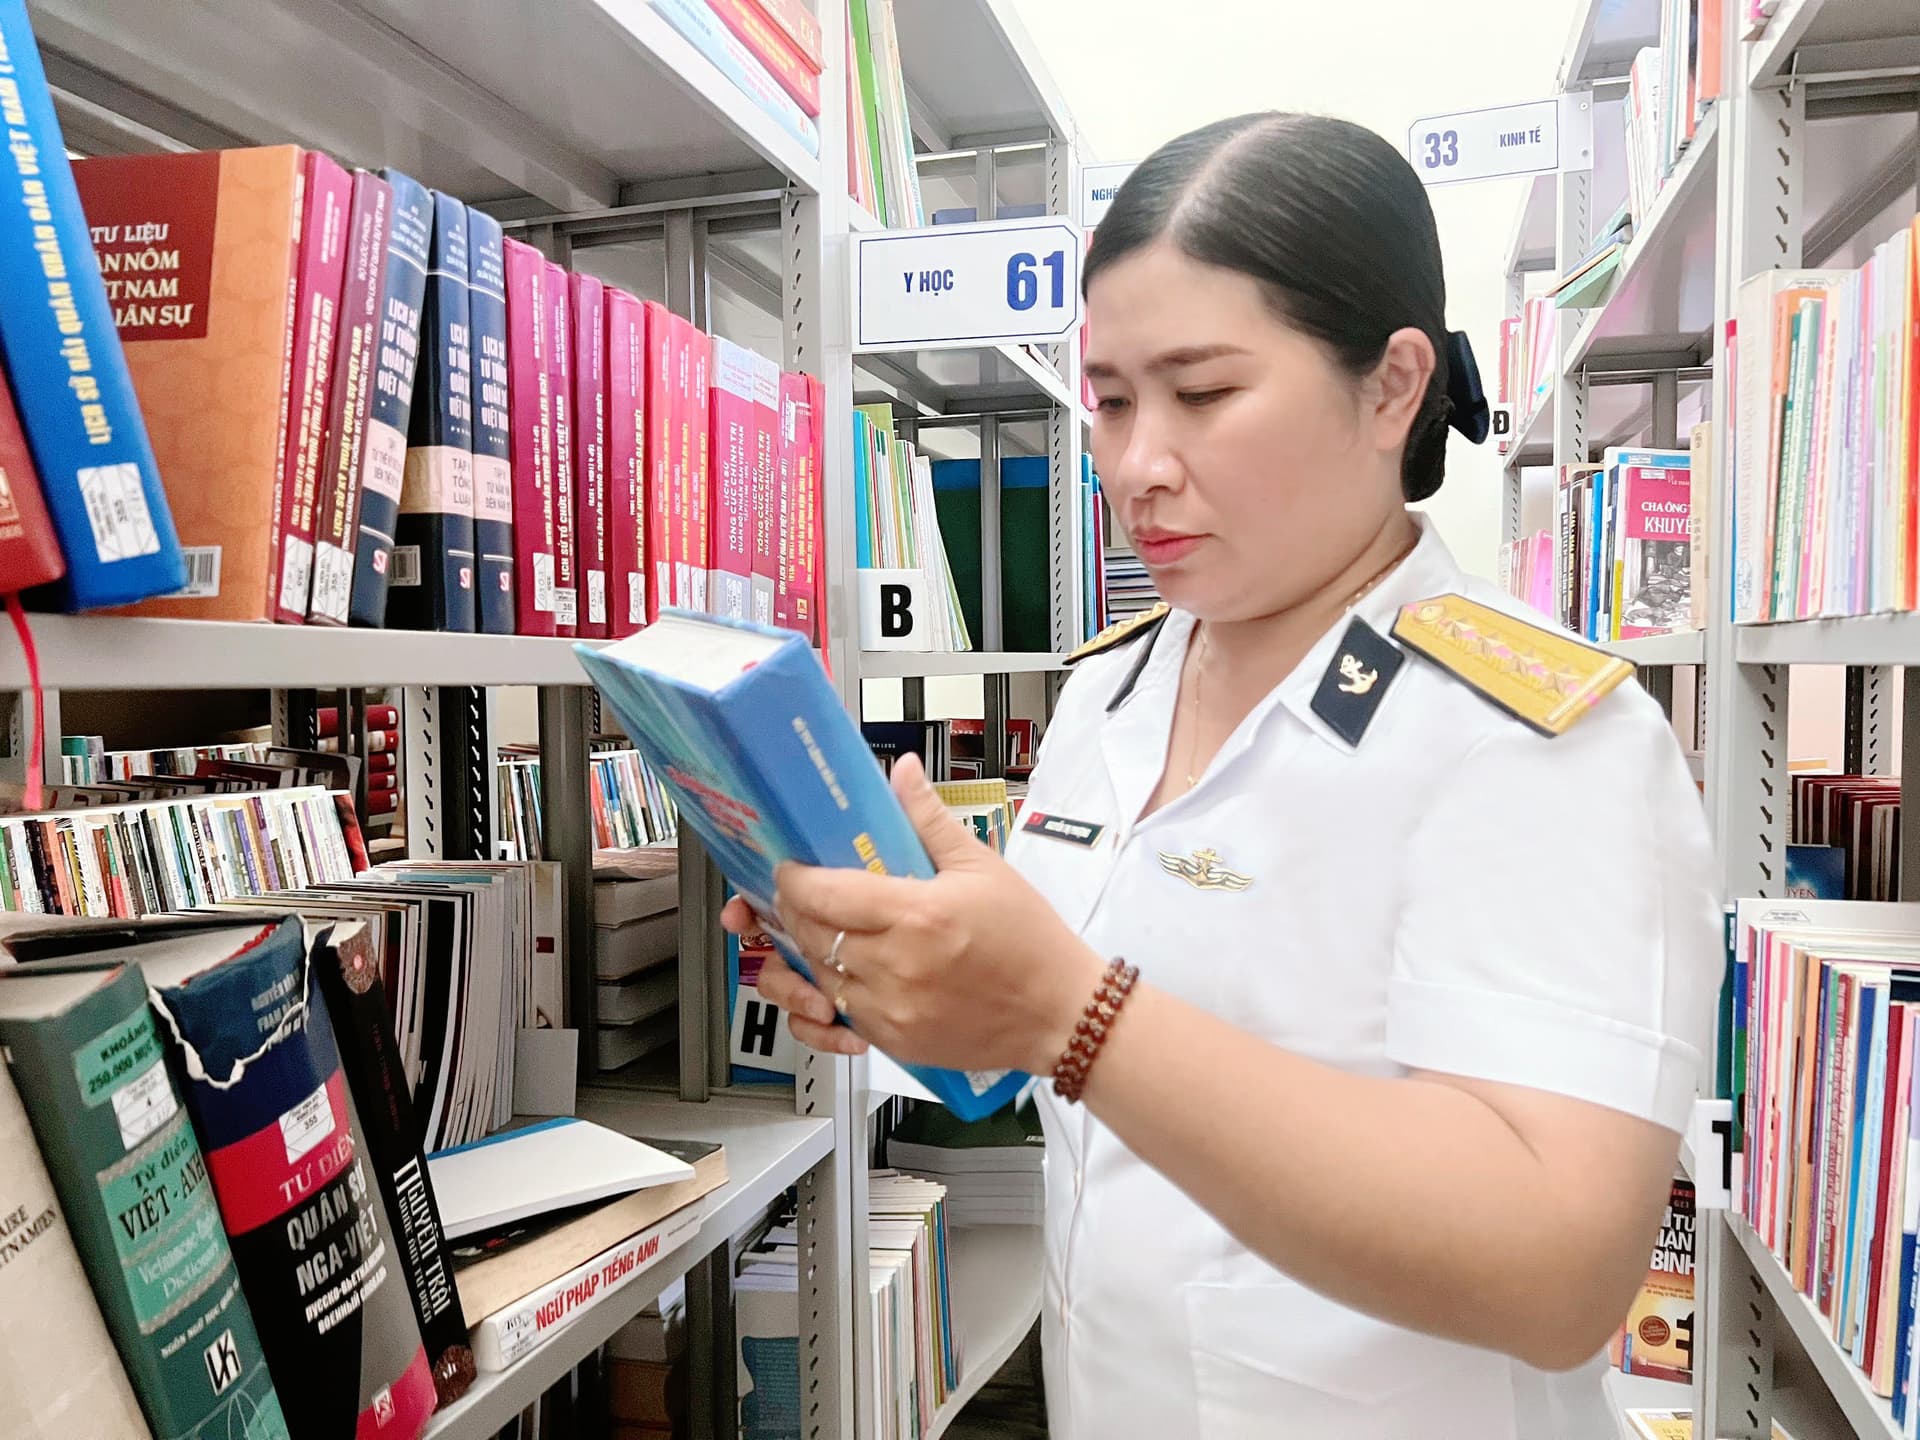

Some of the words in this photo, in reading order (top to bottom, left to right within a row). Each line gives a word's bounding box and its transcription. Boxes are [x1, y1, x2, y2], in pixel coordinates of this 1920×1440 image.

[1425, 130, 1459, 168] 33
[1500, 132, 1525, 148] KINH
[1529, 126, 1542, 144] TẾ
[10, 131, 38, 174] VIỆT
[124, 222, 168, 244] LIỆU
[124, 248, 180, 272] NÔM
[124, 278, 178, 300] NAM
[904, 272, 914, 292] Y
[920, 270, 954, 296] HỌC
[1006, 250, 1065, 311] 61
[159, 303, 194, 328] SỰ
[351, 325, 362, 355] NAM
[348, 356, 359, 379] VIỆT
[345, 379, 357, 399] SỰ
[342, 402, 354, 433] QUÂN
[556, 394, 564, 420] NAM
[556, 421, 564, 444] VIỆT
[1494, 409, 1509, 435] Đ
[337, 435, 351, 471] THUẬT
[557, 446, 565, 460] SỰ
[558, 463, 566, 492] QUÂN
[333, 487, 346, 508] SỬ
[559, 495, 567, 522] CHỨC
[1642, 502, 1664, 512] CHA
[1665, 501, 1687, 513] ÔNG
[330, 508, 344, 537] LỊCH
[560, 524, 568, 538] TỔ
[560, 540, 568, 555] SỬ
[561, 557, 569, 580] LỊCH
[880, 584, 914, 637] B
[741, 1001, 778, 1057] H
[280, 1162, 312, 1203] TỪ
[318, 1128, 356, 1178] ĐIỂN
[119, 1184, 172, 1242] VIỆT
[287, 1183, 350, 1252] QUÂN
[348, 1157, 368, 1203] SỰ
[296, 1203, 378, 1297] NGA-VIỆT
[429, 1257, 451, 1316] TRÃI
[535, 1293, 569, 1332] NGỮ
[567, 1272, 602, 1312] PHÁP
[602, 1253, 636, 1296] TIẾNG
[636, 1235, 660, 1270] ANH
